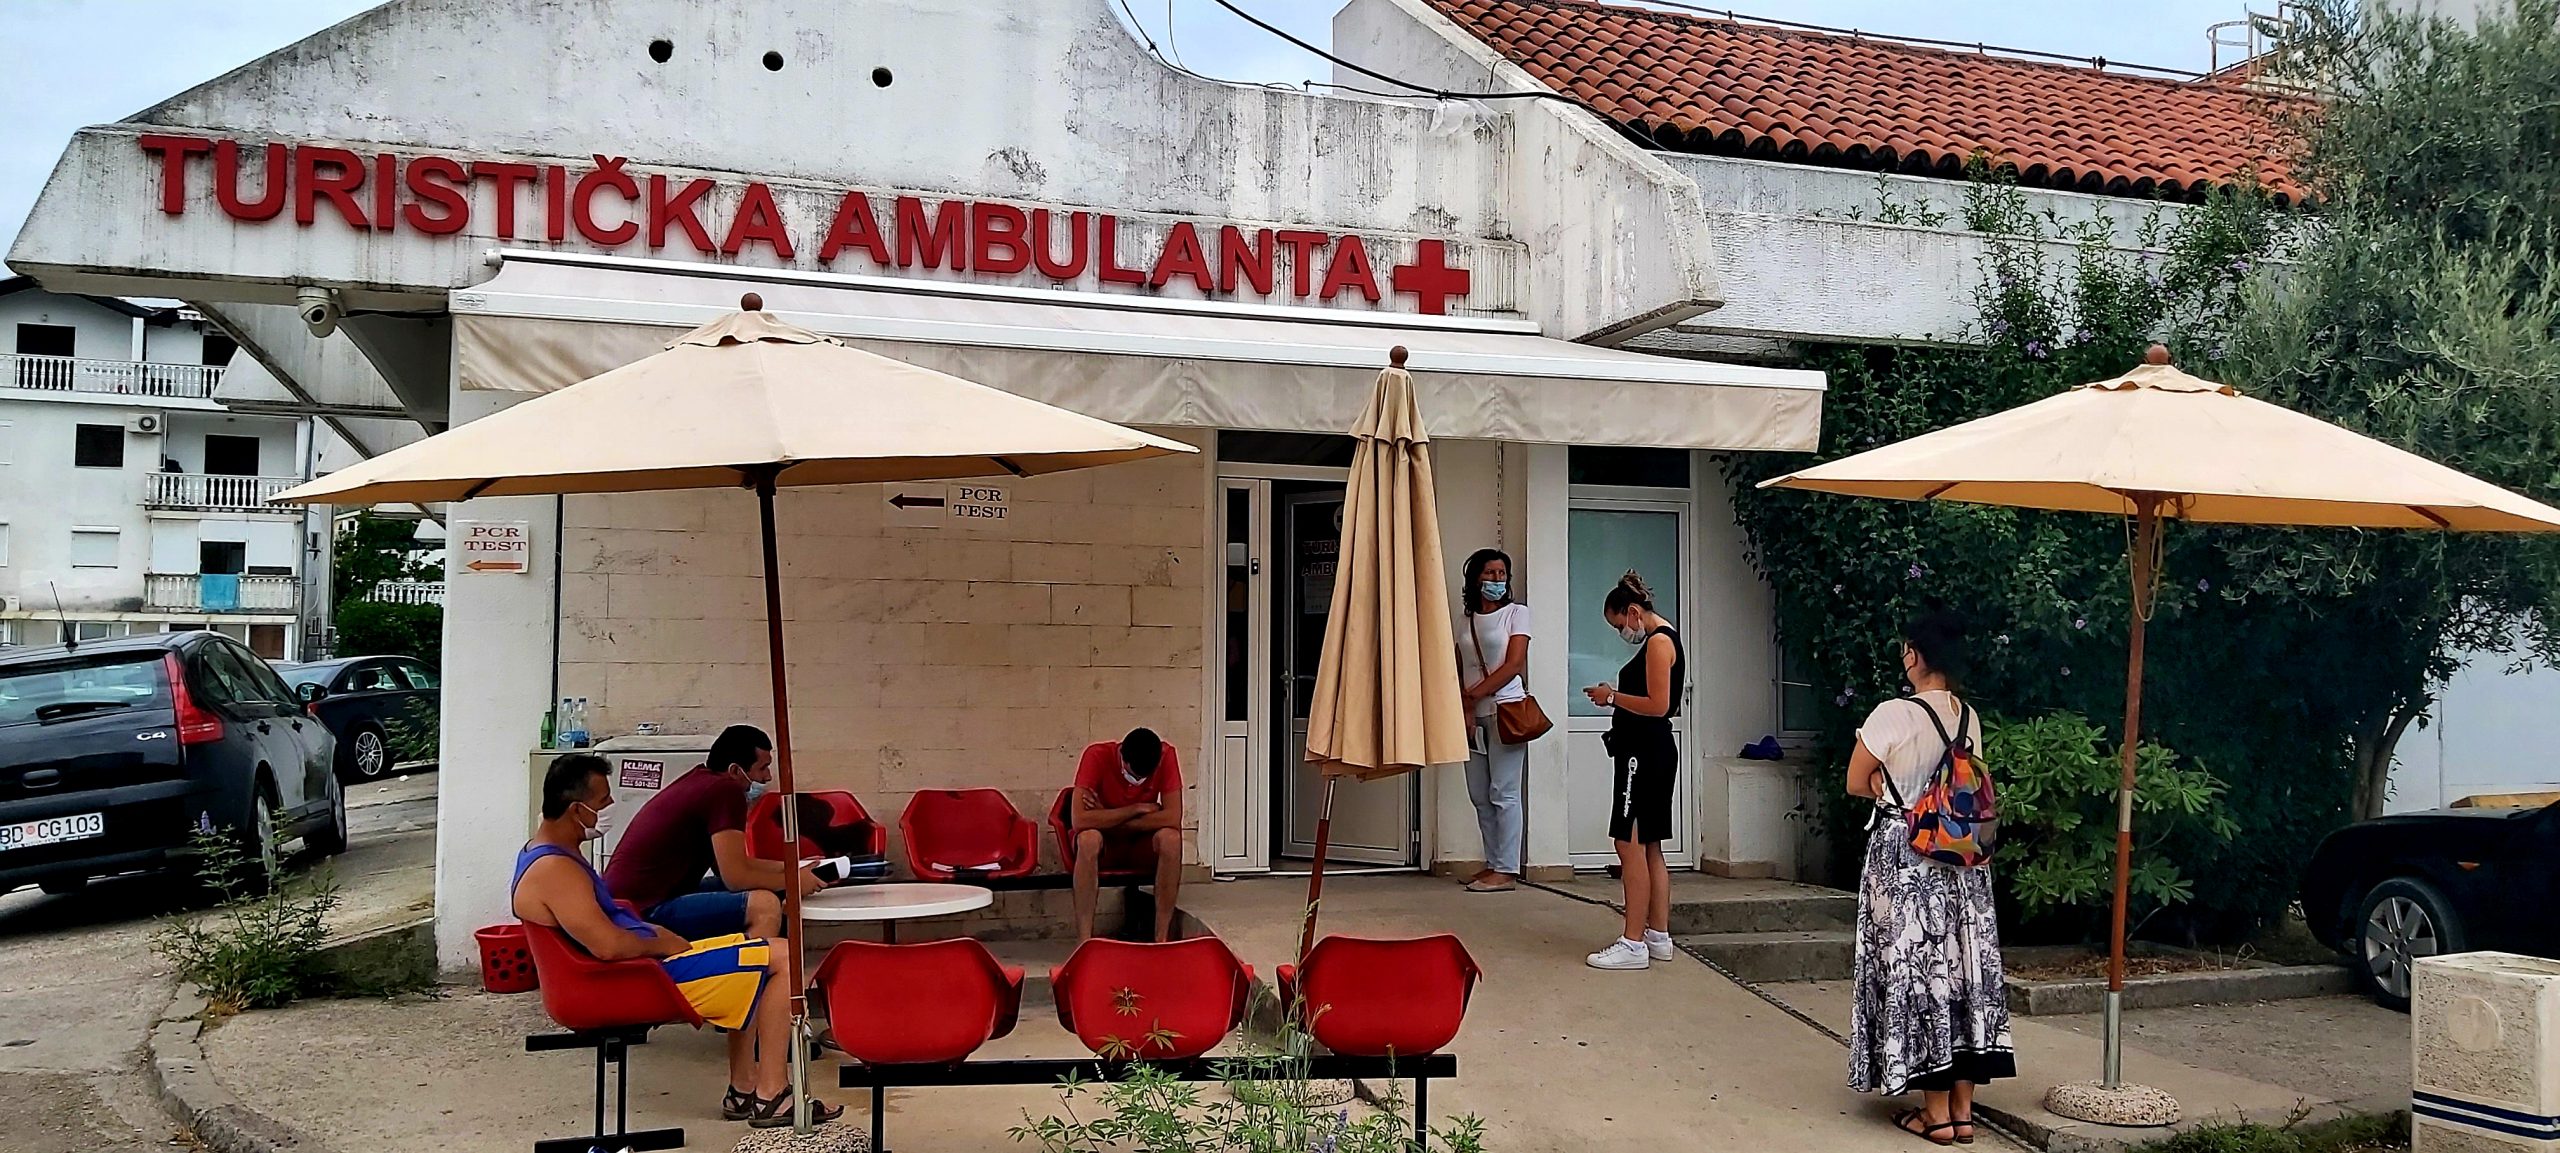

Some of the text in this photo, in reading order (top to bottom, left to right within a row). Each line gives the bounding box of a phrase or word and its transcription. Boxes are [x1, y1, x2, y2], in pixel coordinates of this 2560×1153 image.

[140, 133, 1382, 302] TURISTIČKA AMBULANTA
[960, 487, 1002, 502] PCR
[953, 504, 1008, 519] TEST
[471, 526, 520, 538] PCR
[464, 540, 527, 552] TEST
[136, 731, 167, 741] C4
